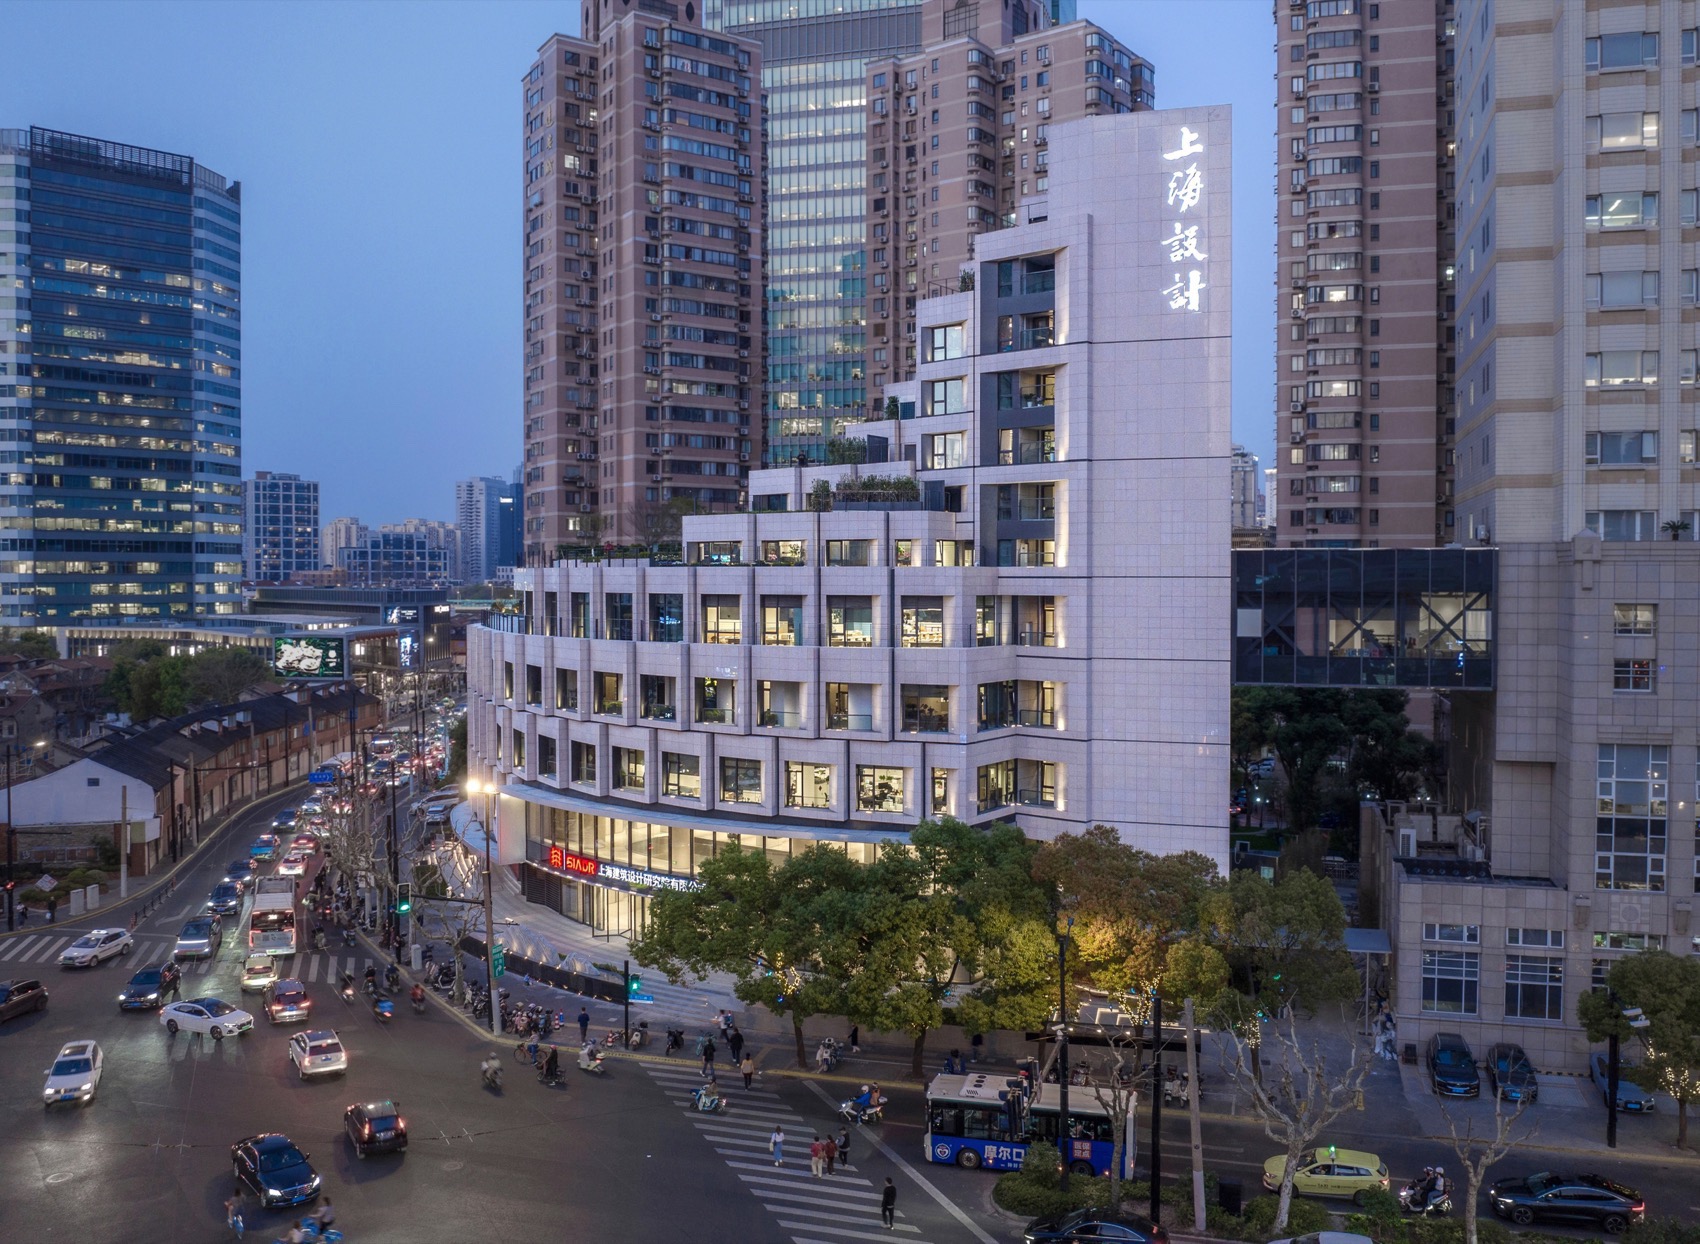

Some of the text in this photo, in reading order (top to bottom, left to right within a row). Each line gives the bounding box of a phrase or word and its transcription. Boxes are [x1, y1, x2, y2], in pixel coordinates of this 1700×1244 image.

[1161, 127, 1208, 311] 上海設計
[566, 856, 595, 875] SIADR
[598, 863, 706, 893] 上海建筑设计研究院有限公
